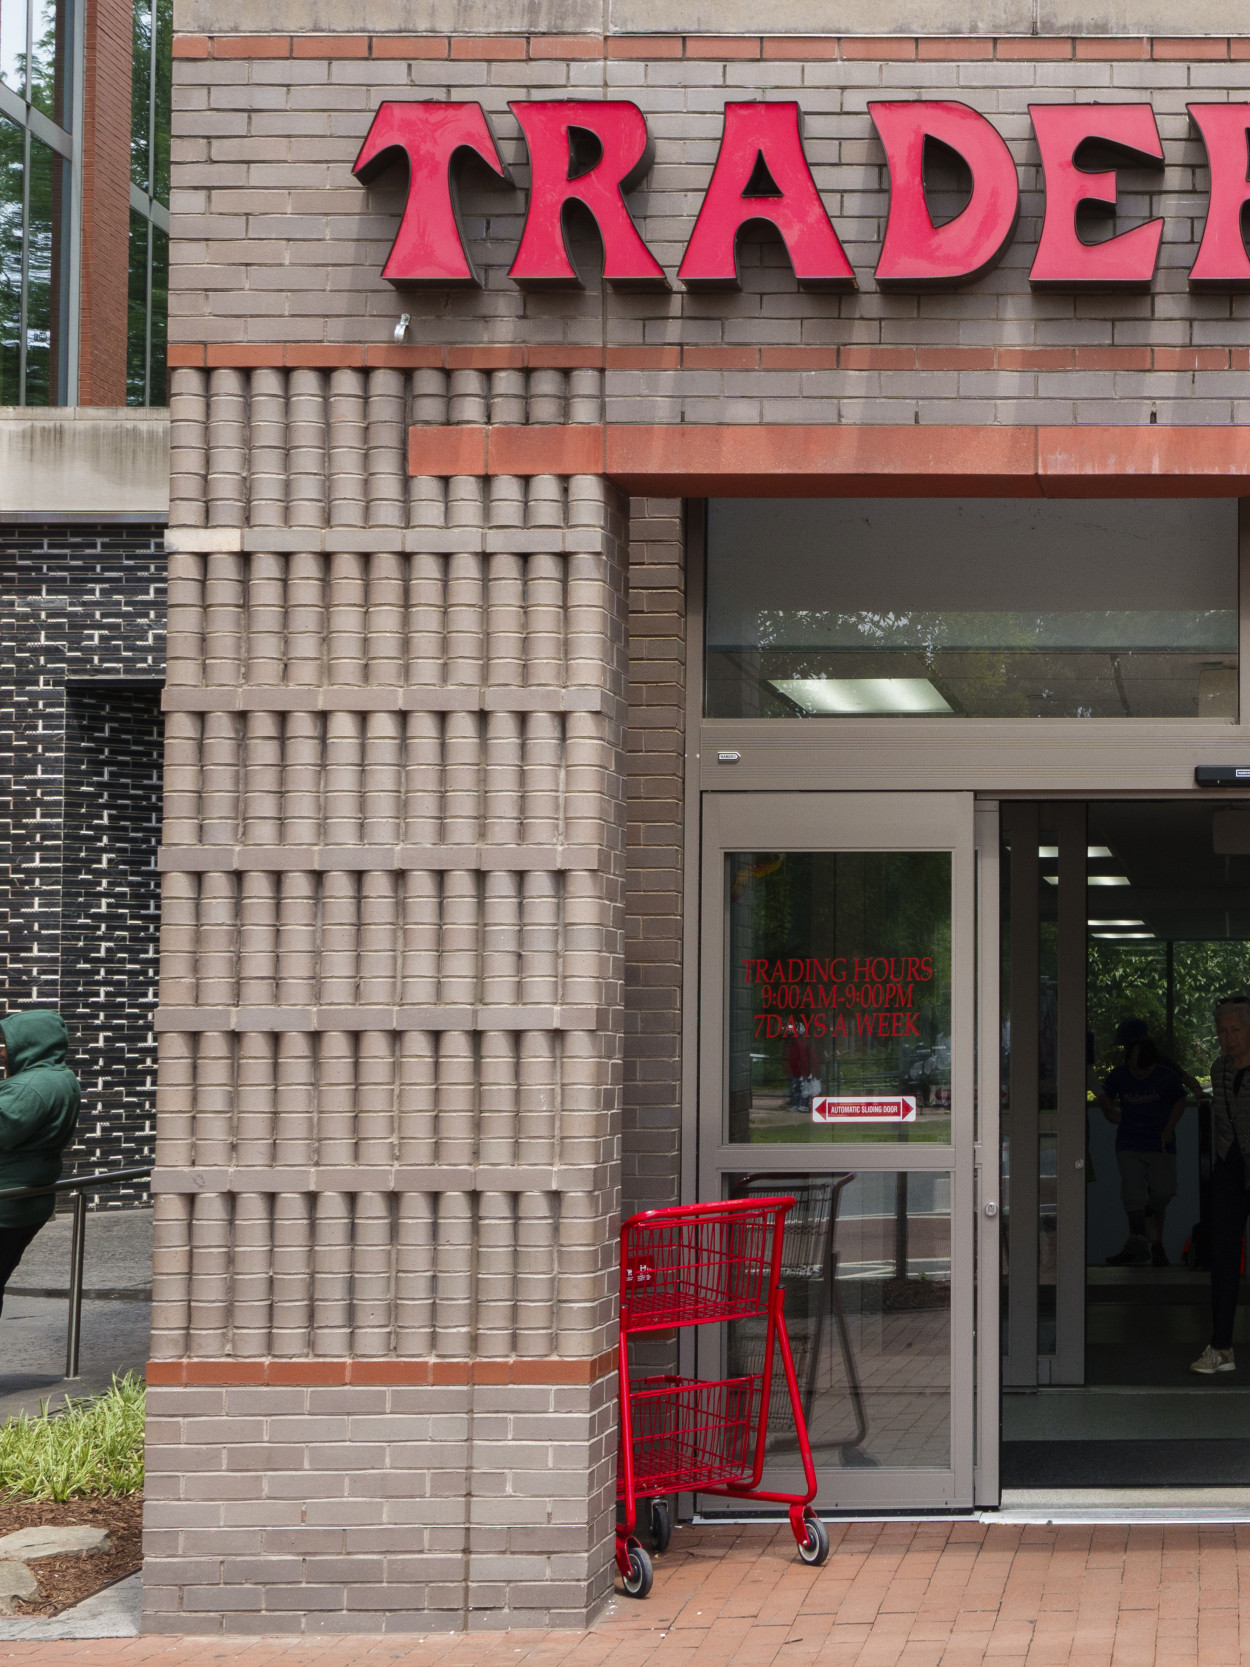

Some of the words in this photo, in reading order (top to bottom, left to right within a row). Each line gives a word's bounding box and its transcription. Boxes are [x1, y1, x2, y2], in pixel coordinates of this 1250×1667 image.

[742, 958, 848, 983] TRADING
[853, 957, 933, 982] HOURS
[832, 1013, 848, 1038] A
[856, 1012, 920, 1037] WEEK
[883, 1105, 898, 1113] DOOR
